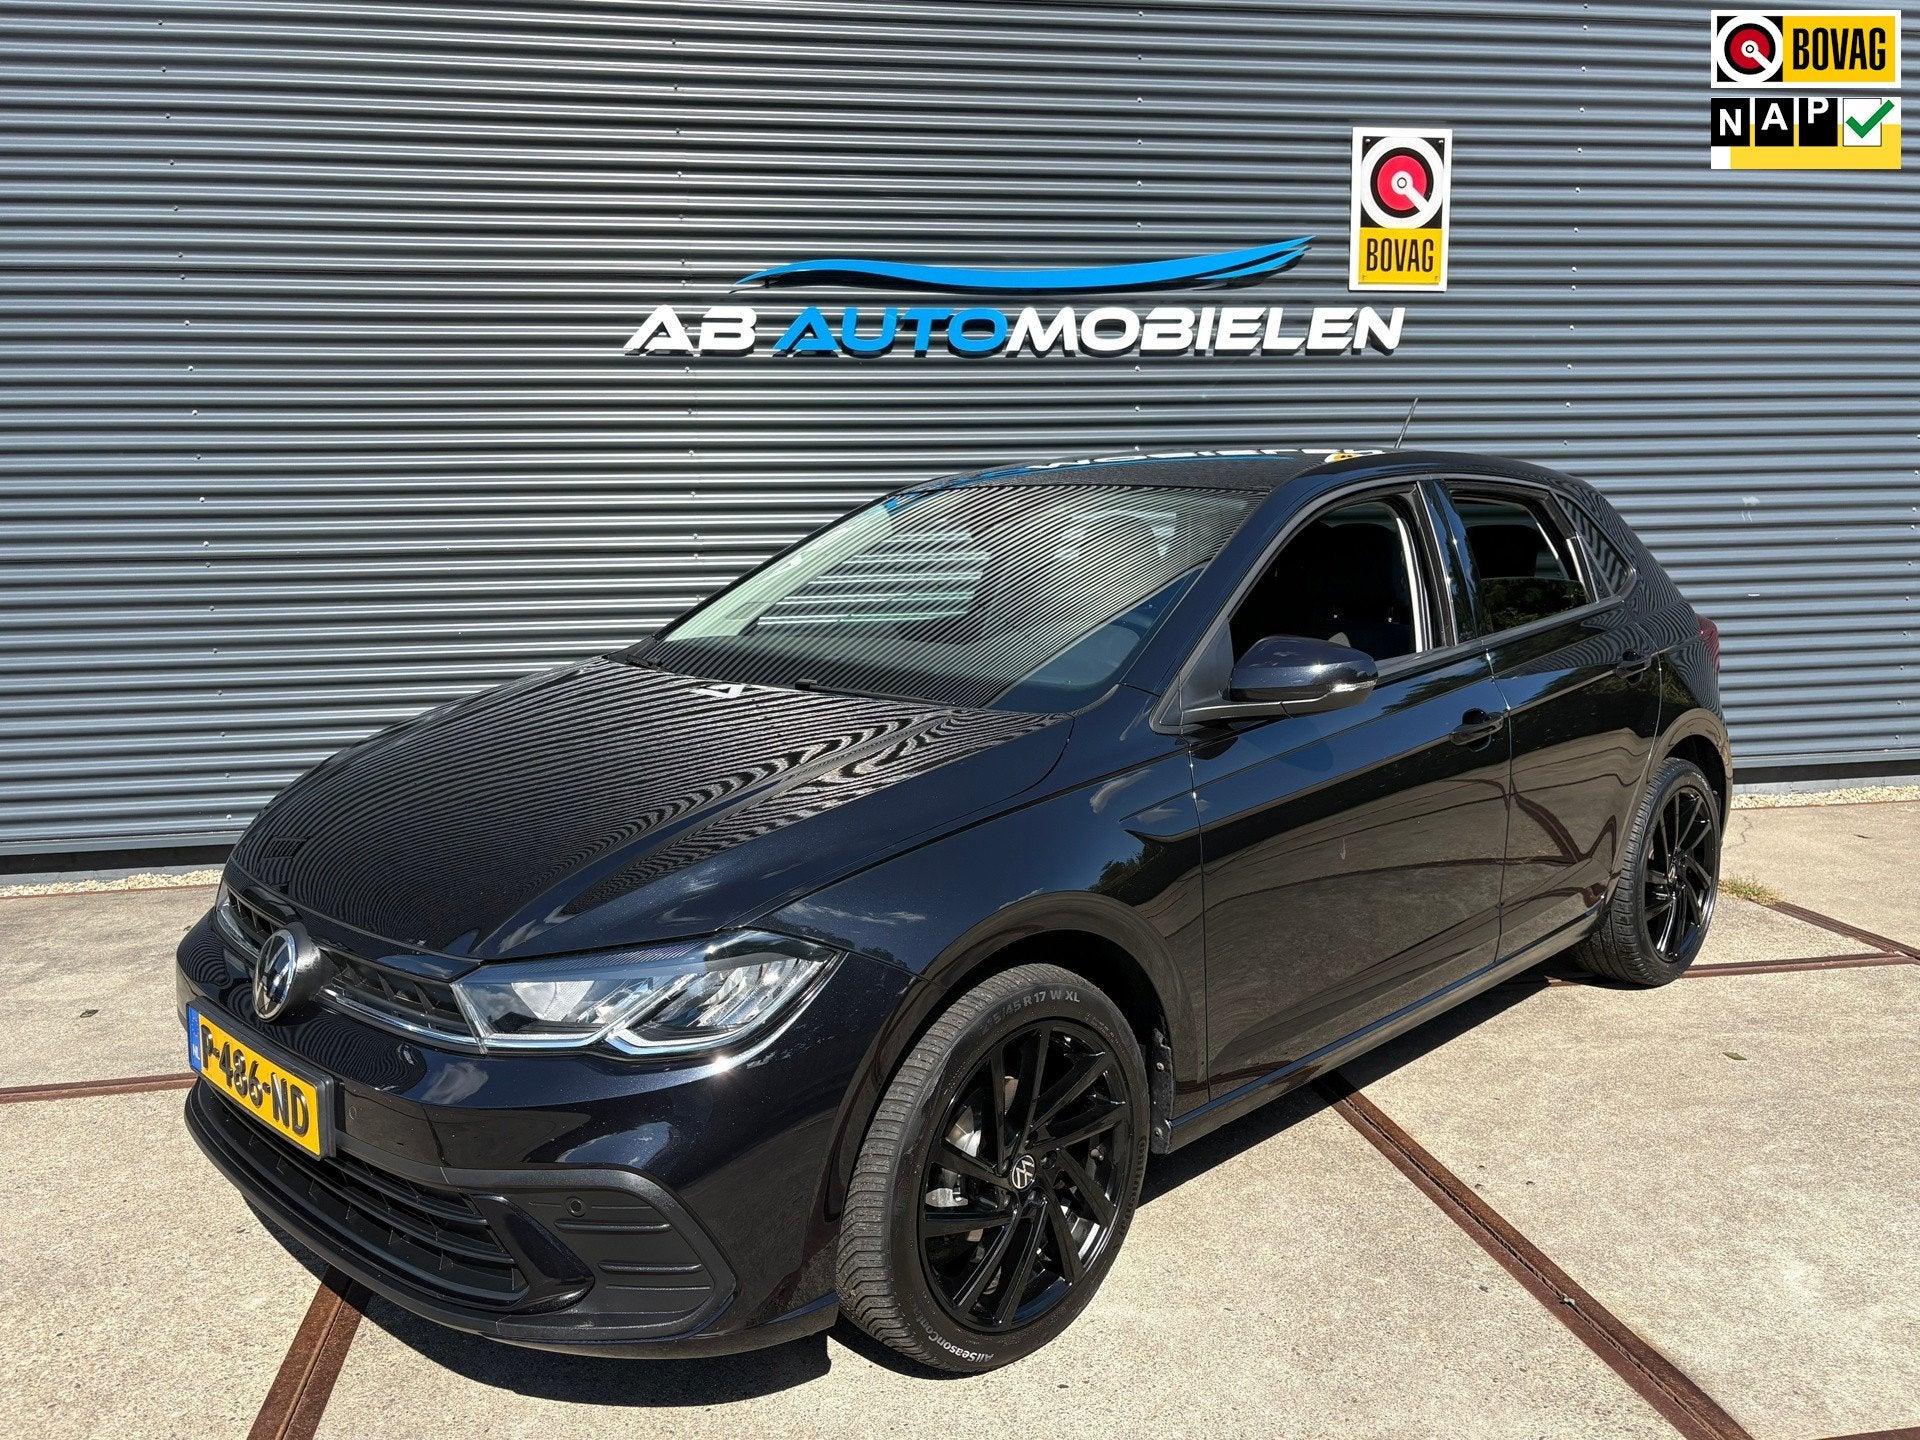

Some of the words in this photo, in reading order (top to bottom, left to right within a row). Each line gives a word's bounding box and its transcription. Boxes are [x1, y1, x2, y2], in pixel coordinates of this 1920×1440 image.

[1366, 237, 1434, 273] BOVAG
[622, 304, 757, 352] AB
[772, 305, 1406, 352] AUTOMOBIELEN
[1022, 994, 1033, 1008] R
[1033, 990, 1047, 1004] 17
[1049, 990, 1062, 1001] W
[1065, 990, 1081, 1003] XL
[200, 1024, 310, 1138] P-486-ND
[914, 1304, 995, 1363] AllSeasonConta
